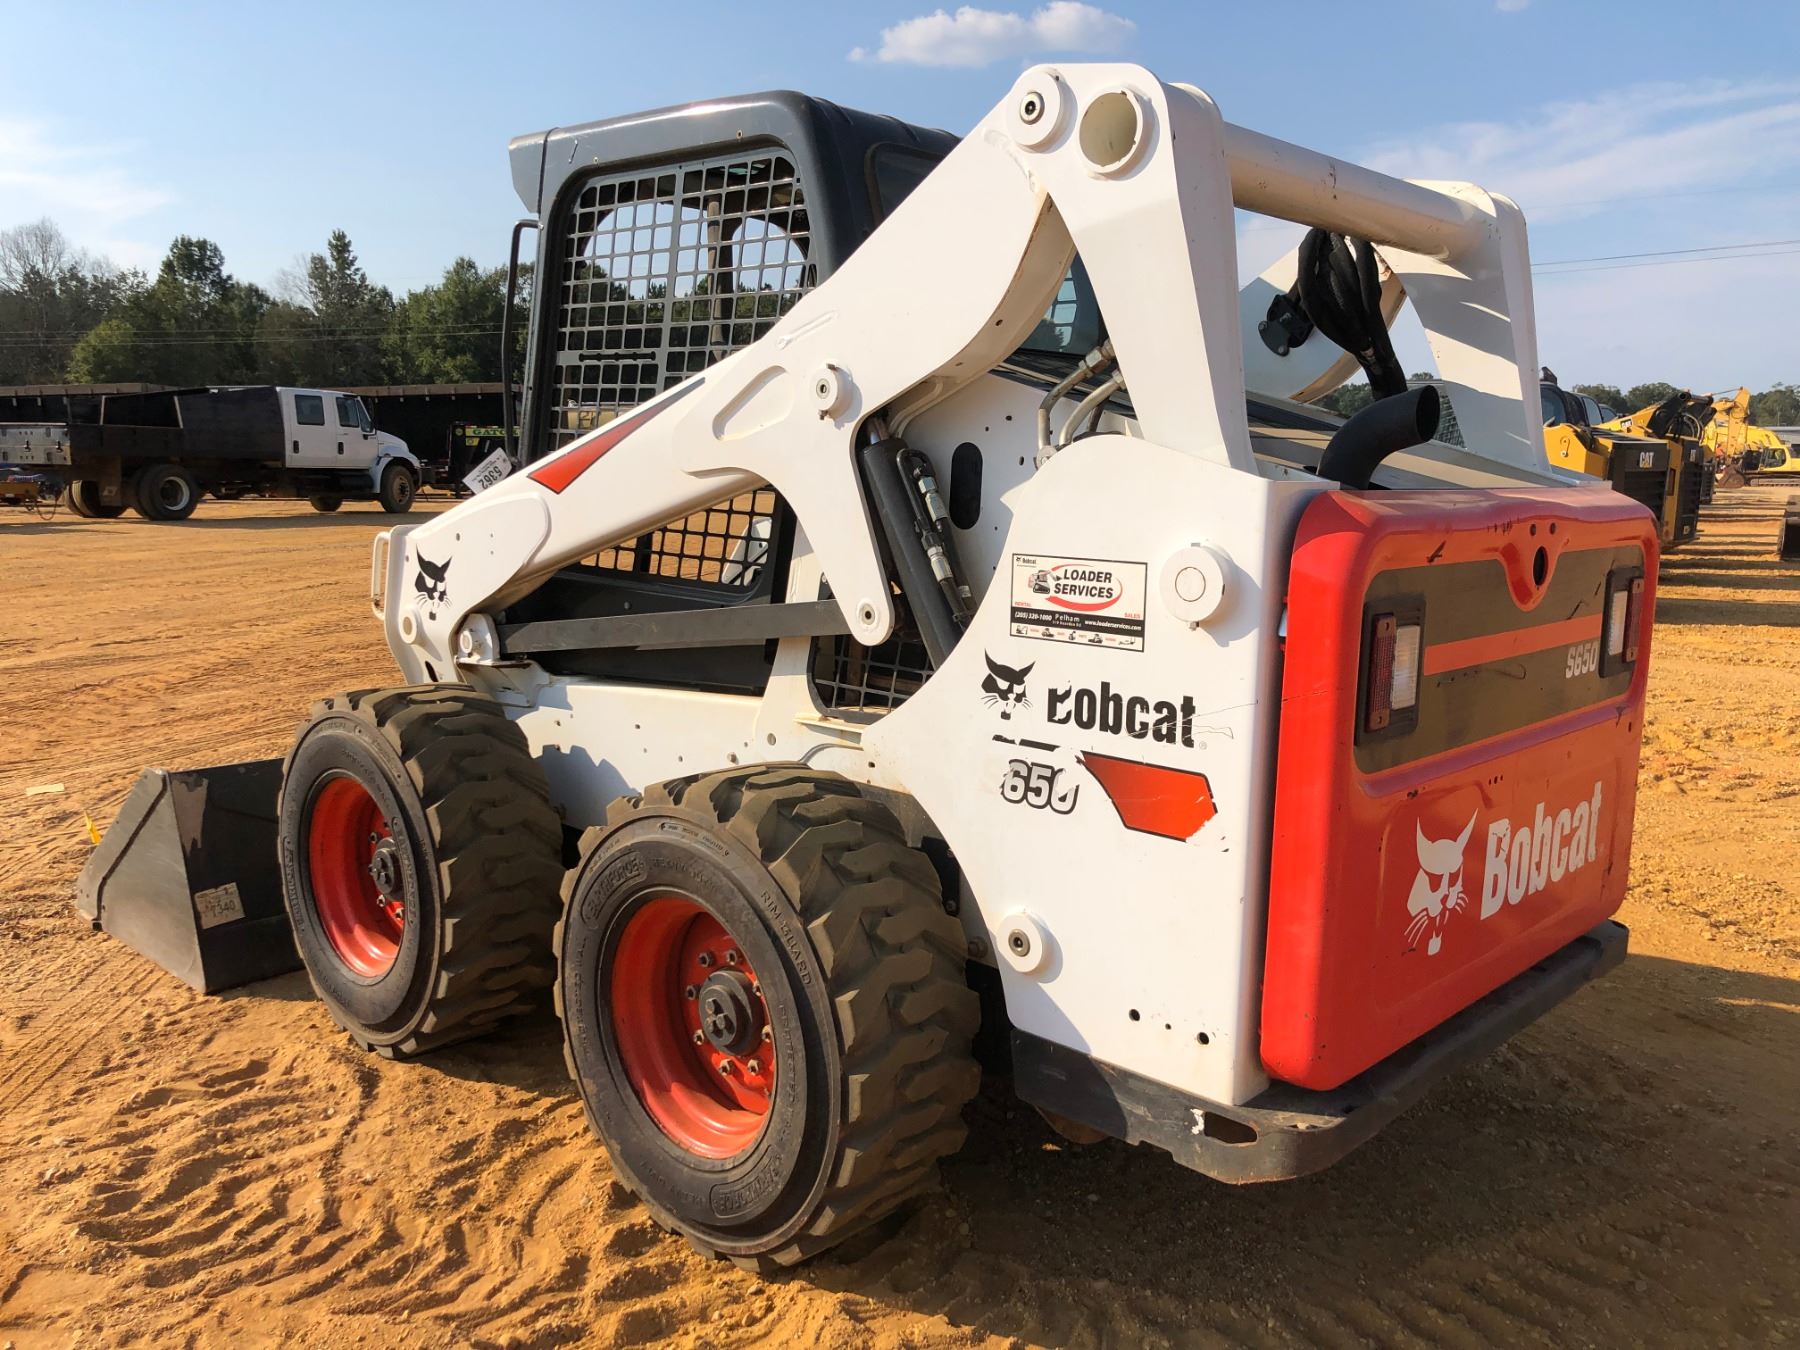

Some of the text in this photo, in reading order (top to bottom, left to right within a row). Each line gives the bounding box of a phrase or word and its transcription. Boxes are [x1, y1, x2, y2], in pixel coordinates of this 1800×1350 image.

[1639, 451, 1655, 468] CAT
[1063, 568, 1113, 584] LOADER
[1053, 582, 1114, 599] SERVICES
[1054, 613, 1080, 623] Pelham
[1565, 641, 1599, 679] S650
[1480, 781, 1602, 921] Bobcat
